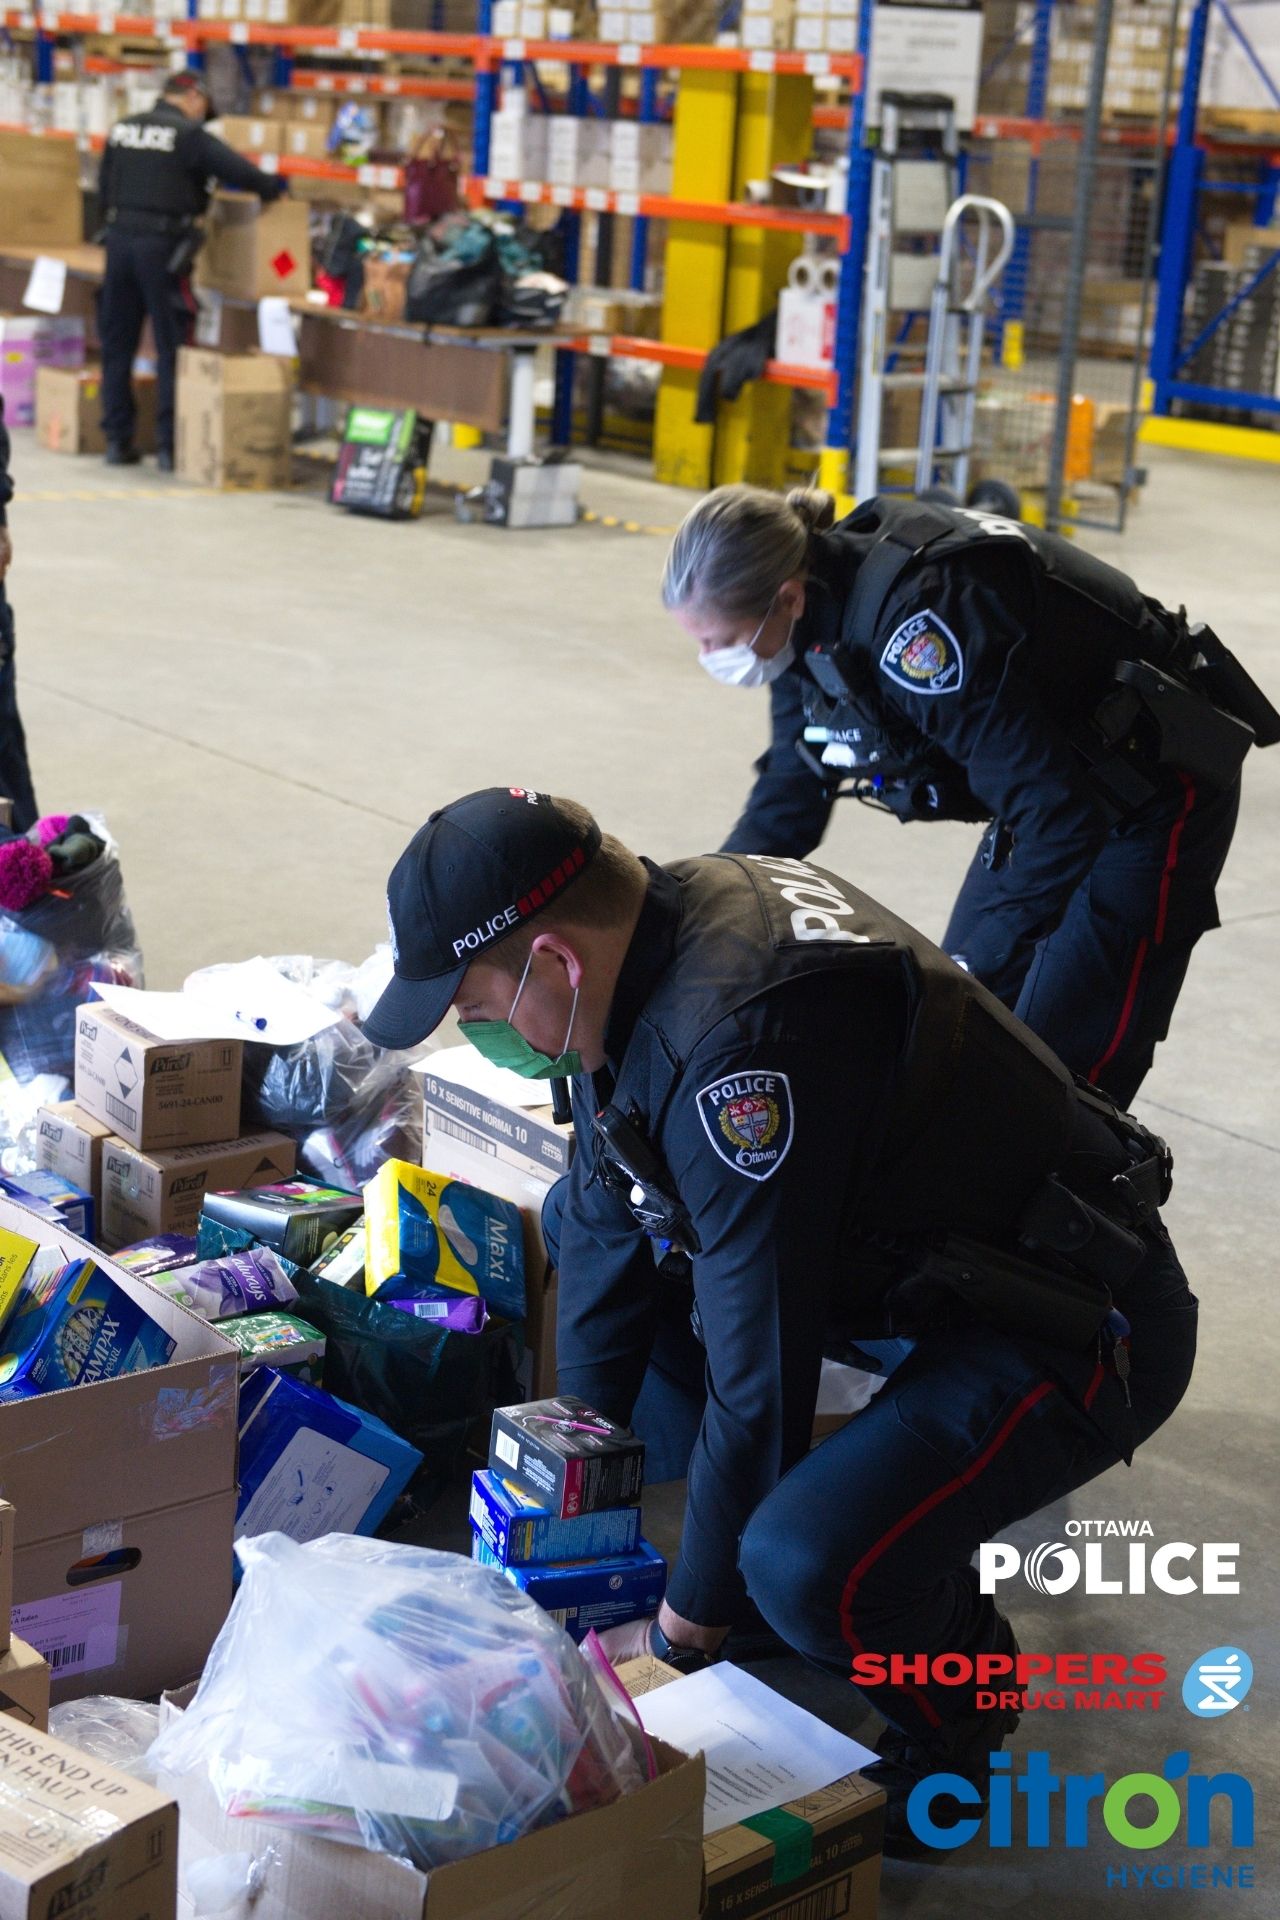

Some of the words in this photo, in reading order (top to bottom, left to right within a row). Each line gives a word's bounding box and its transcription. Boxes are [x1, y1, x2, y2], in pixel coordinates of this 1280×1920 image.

[109, 123, 177, 152] POLICE
[886, 617, 928, 665] POLICE
[452, 904, 520, 958] POLICE
[708, 1077, 776, 1107] POLICE
[425, 1077, 438, 1096] 16
[445, 1091, 482, 1121] SENSITIVE
[482, 1110, 515, 1138] NORMAL
[515, 1125, 529, 1145] 10
[735, 1147, 778, 1167] Ottawa
[426, 1180, 437, 1198] 24
[7, 1253, 18, 1265] les
[489, 1217, 511, 1284] Maxi
[231, 1258, 267, 1301] always
[0, 1726, 44, 1757] THIS
[38, 1752, 91, 1782] END
[89, 1777, 129, 1799] UP
[15, 1765, 86, 1801] HAUT
[825, 1844, 839, 1861] 10
[744, 1878, 776, 1901] SENSIT
